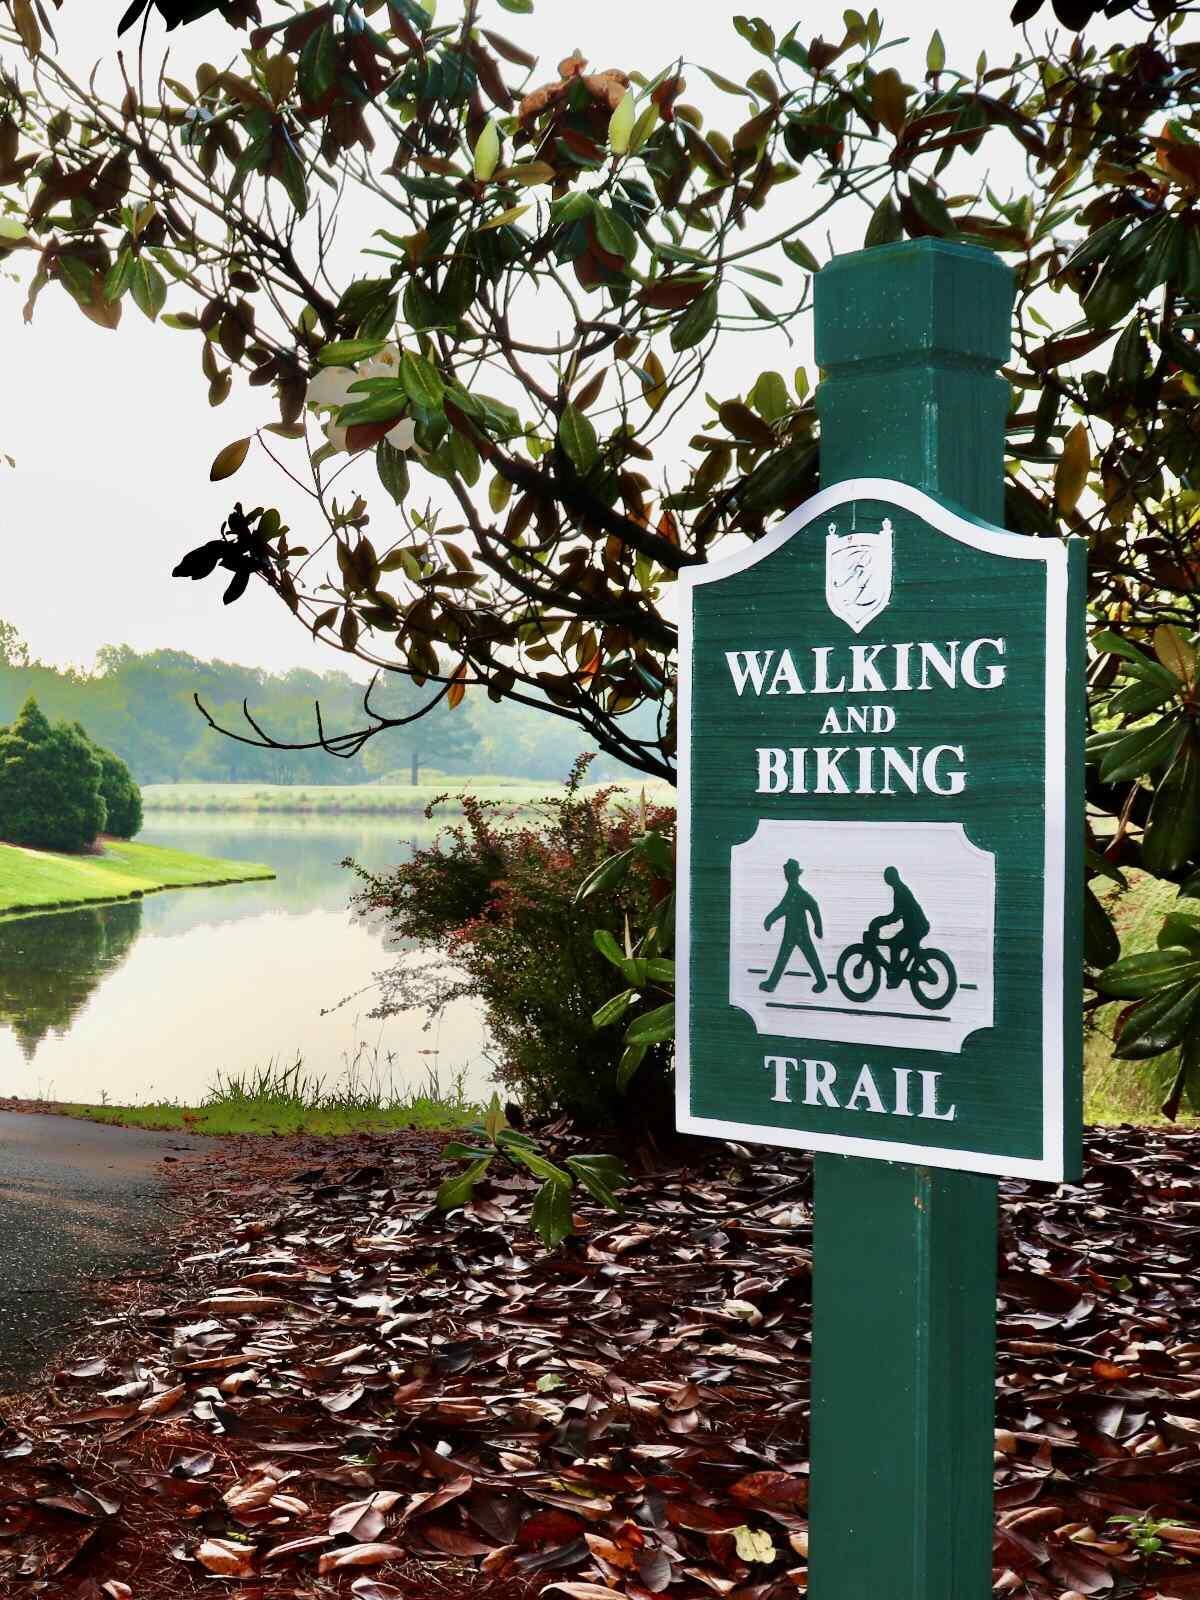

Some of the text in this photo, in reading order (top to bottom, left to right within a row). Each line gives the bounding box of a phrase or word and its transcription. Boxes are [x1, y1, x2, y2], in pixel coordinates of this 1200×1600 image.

[724, 636, 1007, 697] WALKING
[819, 705, 896, 734] AND
[755, 744, 968, 796] BIKING
[763, 1055, 956, 1122] TRAIL
